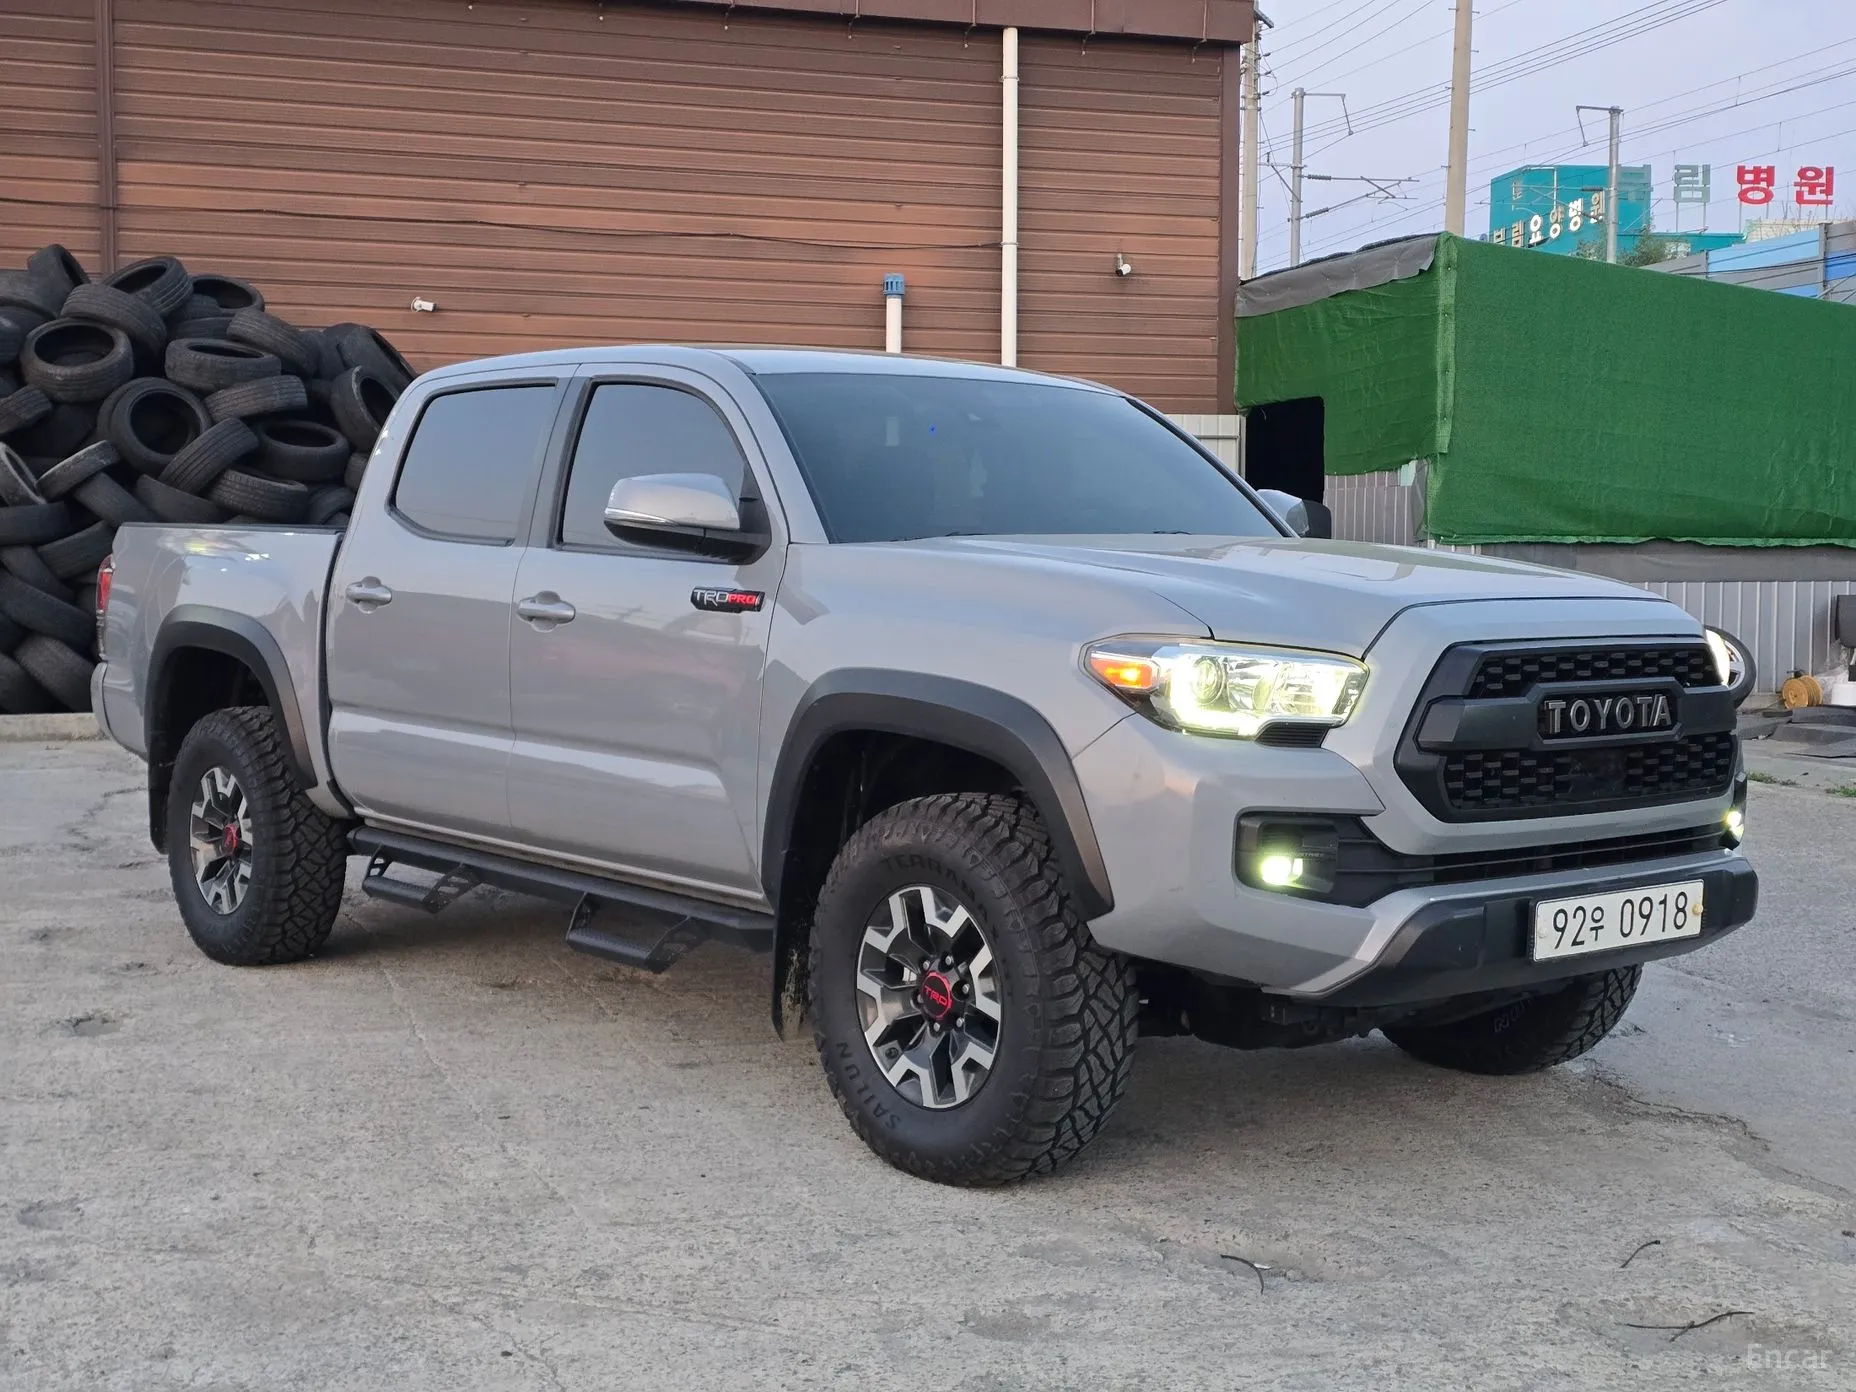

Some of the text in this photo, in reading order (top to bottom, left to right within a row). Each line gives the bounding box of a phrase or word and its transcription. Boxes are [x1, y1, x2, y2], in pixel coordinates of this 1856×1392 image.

[1545, 693, 1673, 734] TOYOTA
[1552, 891, 1688, 949] 92우 0918
[924, 984, 948, 1006] TRD
[835, 1041, 902, 1130] SAILUN
